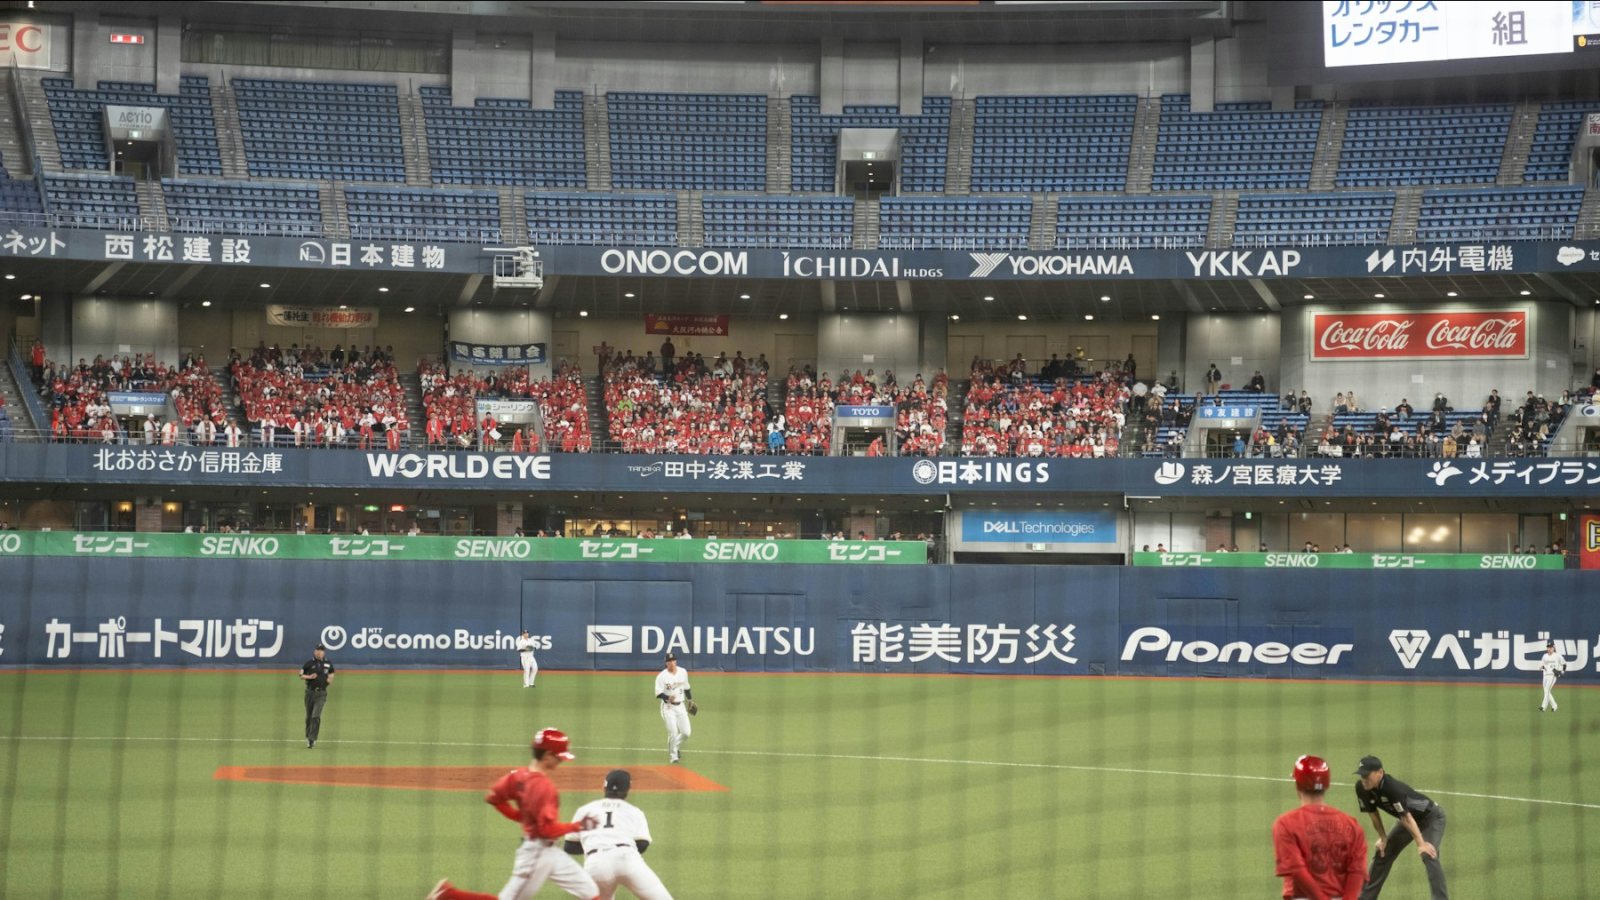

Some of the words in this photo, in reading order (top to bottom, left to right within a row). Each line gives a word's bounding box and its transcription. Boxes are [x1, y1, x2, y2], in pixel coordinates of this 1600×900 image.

[1332, 20, 1440, 48] レンタカー
[1492, 11, 1527, 45] 組
[0, 229, 66, 256] ネット
[105, 235, 251, 264] 西松建設
[331, 245, 446, 269] 日本建物
[600, 249, 748, 275] ONOCOM
[1010, 255, 1135, 275] YOKOHAMA
[1186, 251, 1252, 276] YKK
[1257, 251, 1301, 276] AP
[1402, 245, 1514, 272] 内外電機
[903, 268, 944, 278] HLDGS
[1321, 320, 1414, 351] Coca-Cola
[1426, 318, 1523, 349] Coca-Cola
[851, 408, 880, 416] TOTO
[93, 448, 283, 474] 北おおさか信用金庫
[665, 460, 806, 480] 田中浚渫工業
[1469, 461, 1600, 485] メディプラン
[1192, 465, 1342, 486] 森ノ宮医療大学
[984, 521, 1019, 533] DELL
[1020, 521, 1095, 537] Technologies
[72, 534, 149, 554] センコー
[200, 537, 279, 556] SENKO
[330, 538, 405, 556] センコー
[454, 540, 531, 559] SENKO
[580, 540, 654, 559] センコー
[703, 541, 779, 561] SENKO
[827, 543, 902, 561] センコー
[1160, 553, 1213, 566] センコー
[1265, 554, 1319, 568] SENKO
[1372, 554, 1425, 568] センコー
[1480, 556, 1536, 569] SENKO
[46, 616, 284, 658] カーポートマルゼン
[351, 628, 450, 650] docomo
[454, 629, 553, 651] Businss
[641, 625, 815, 657] DAIHATSU
[851, 622, 1077, 664] 能美防災
[1121, 627, 1354, 665] Pioneer
[1432, 630, 1600, 673] ベガビッ
[603, 811, 615, 829] 1
